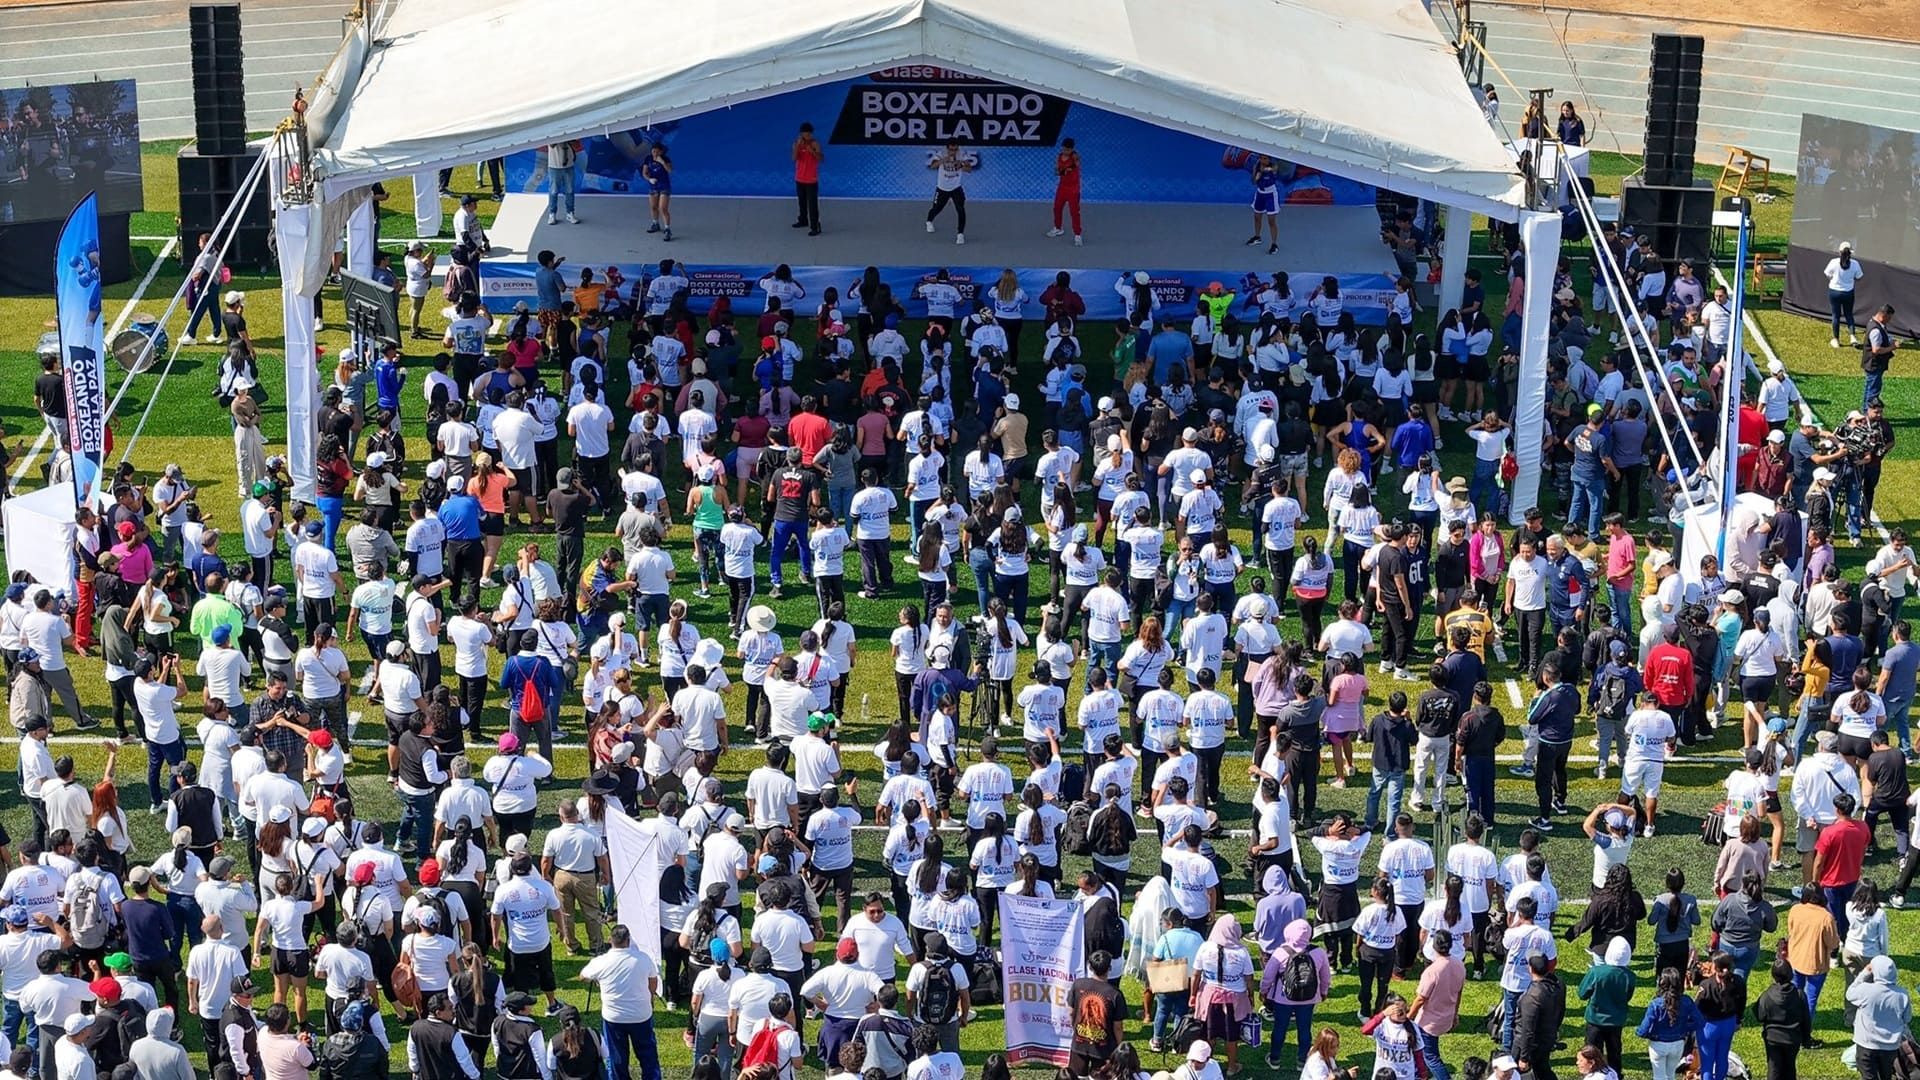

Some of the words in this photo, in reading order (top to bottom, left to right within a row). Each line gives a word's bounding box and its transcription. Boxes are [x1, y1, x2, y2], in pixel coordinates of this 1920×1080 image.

[862, 91, 1044, 116] BOXEANDO
[864, 118, 926, 139] POR
[936, 119, 974, 140] LA
[983, 120, 1041, 141] PAZ
[85, 358, 98, 391] PAZ
[73, 359, 95, 453] BOXEANDO
[90, 396, 99, 418] LA
[782, 480, 801, 497] 22
[1008, 965, 1037, 975] CLASE
[1008, 982, 1067, 1008] BOXE
